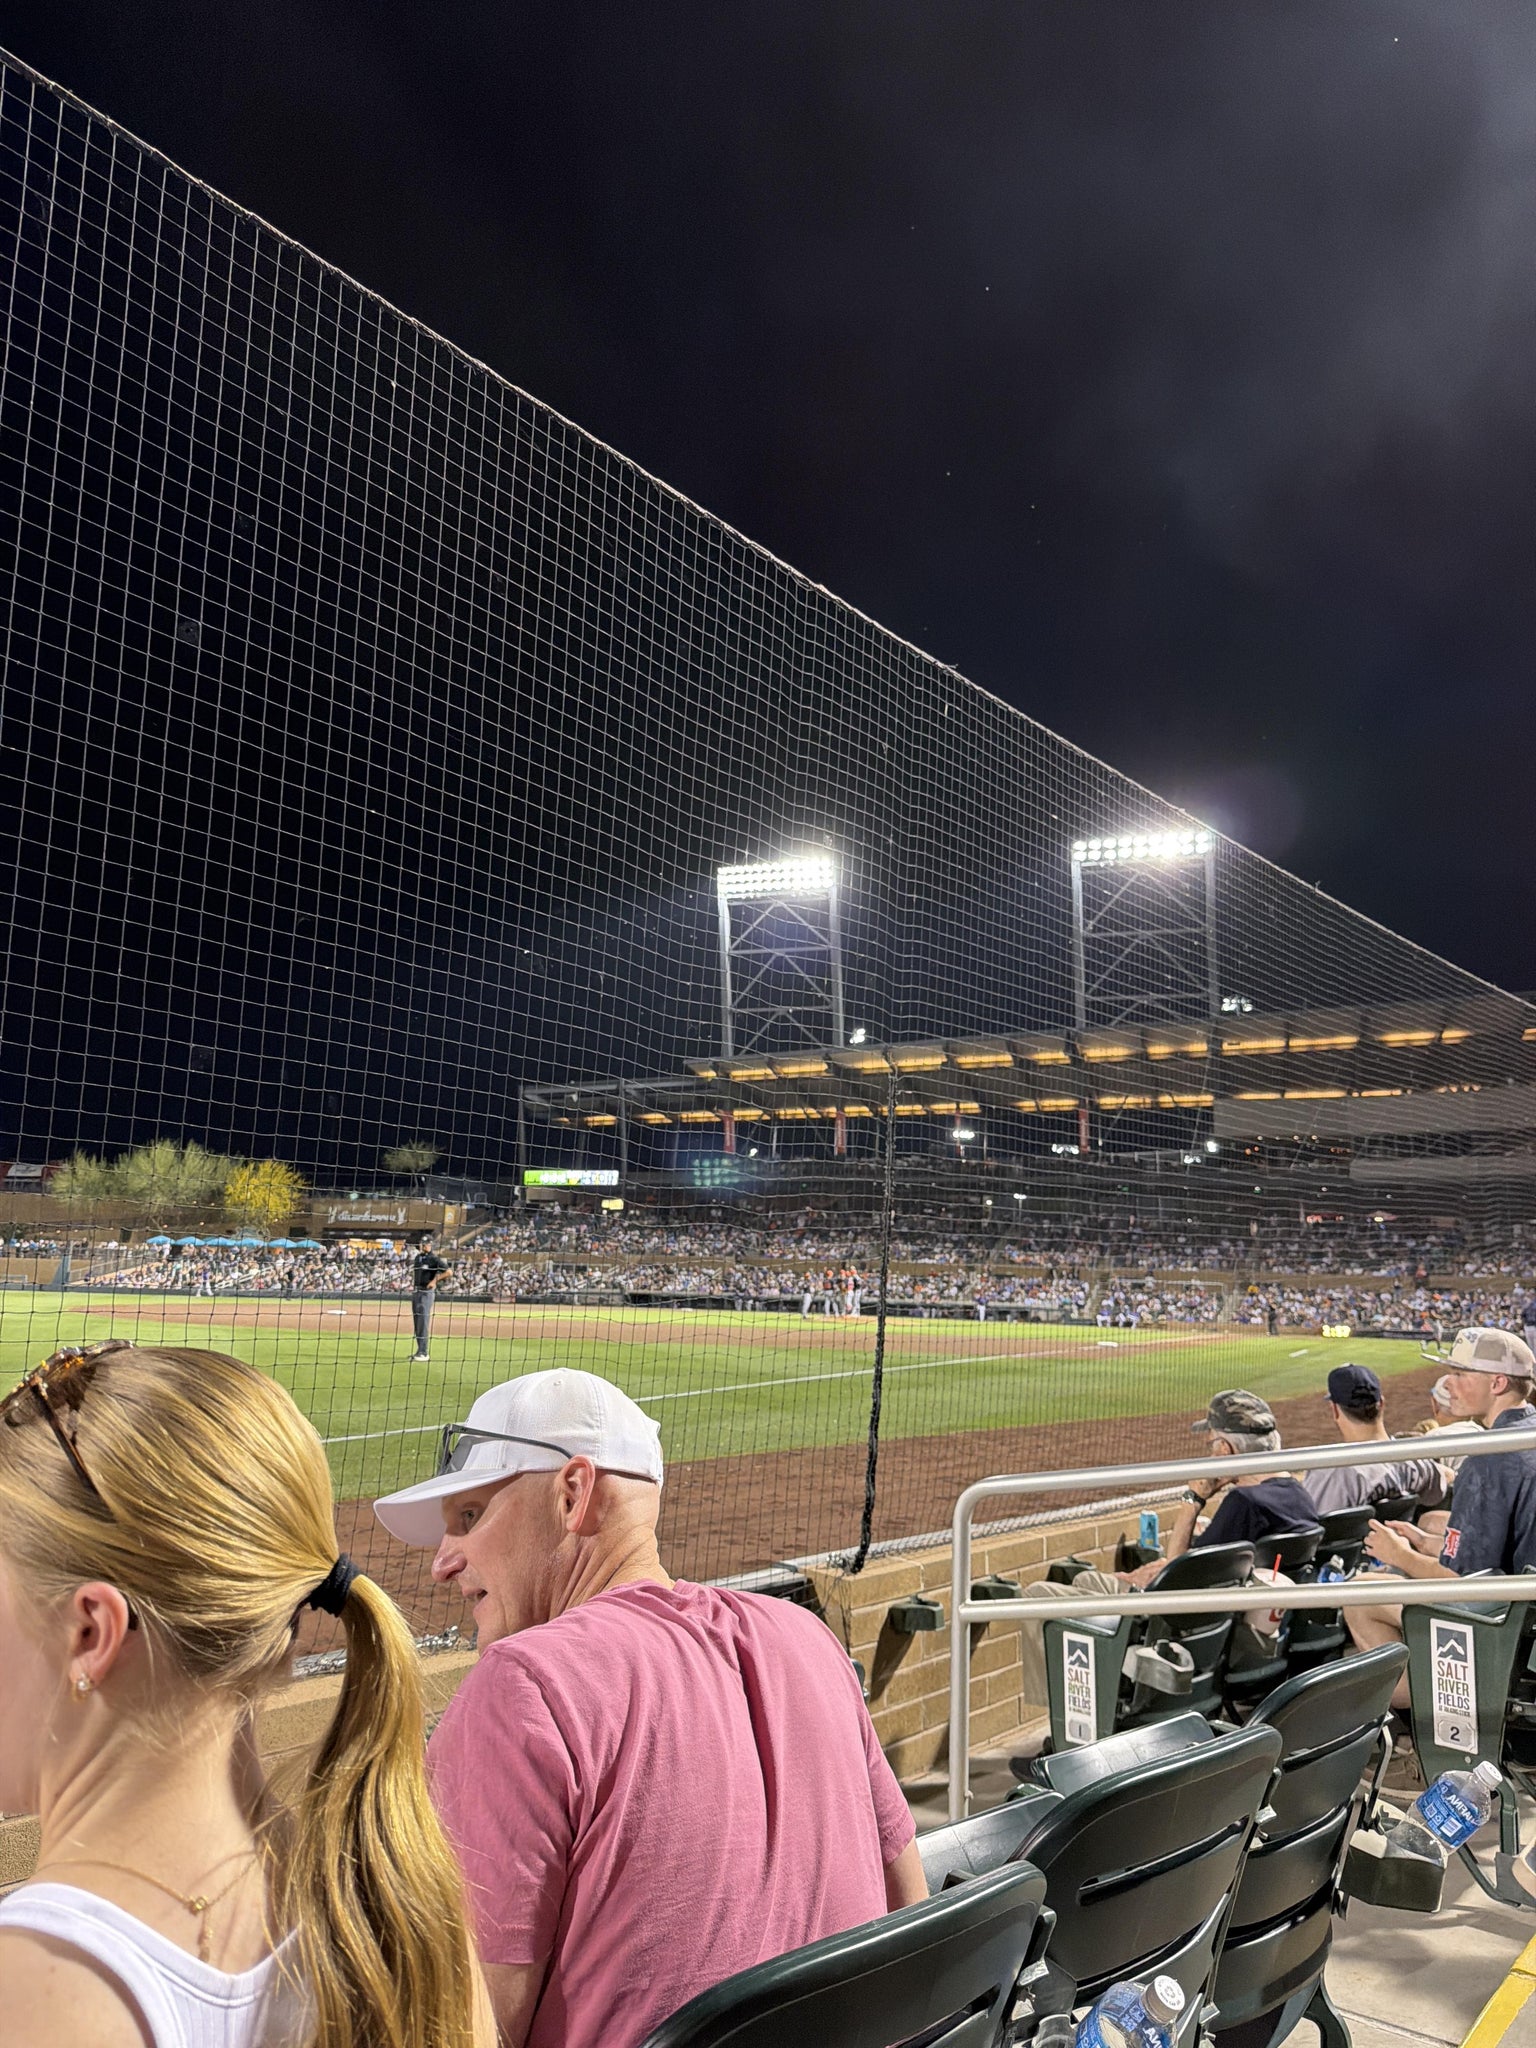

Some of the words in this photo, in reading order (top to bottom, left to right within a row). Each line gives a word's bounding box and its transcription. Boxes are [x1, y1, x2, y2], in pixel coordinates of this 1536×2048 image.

[1067, 1667, 1090, 1686] SALT
[1437, 1660, 1469, 1682] SALT
[1437, 1677, 1470, 1698] RIVER
[1438, 1691, 1470, 1711] FIELDS
[1450, 1726, 1460, 1742] 2
